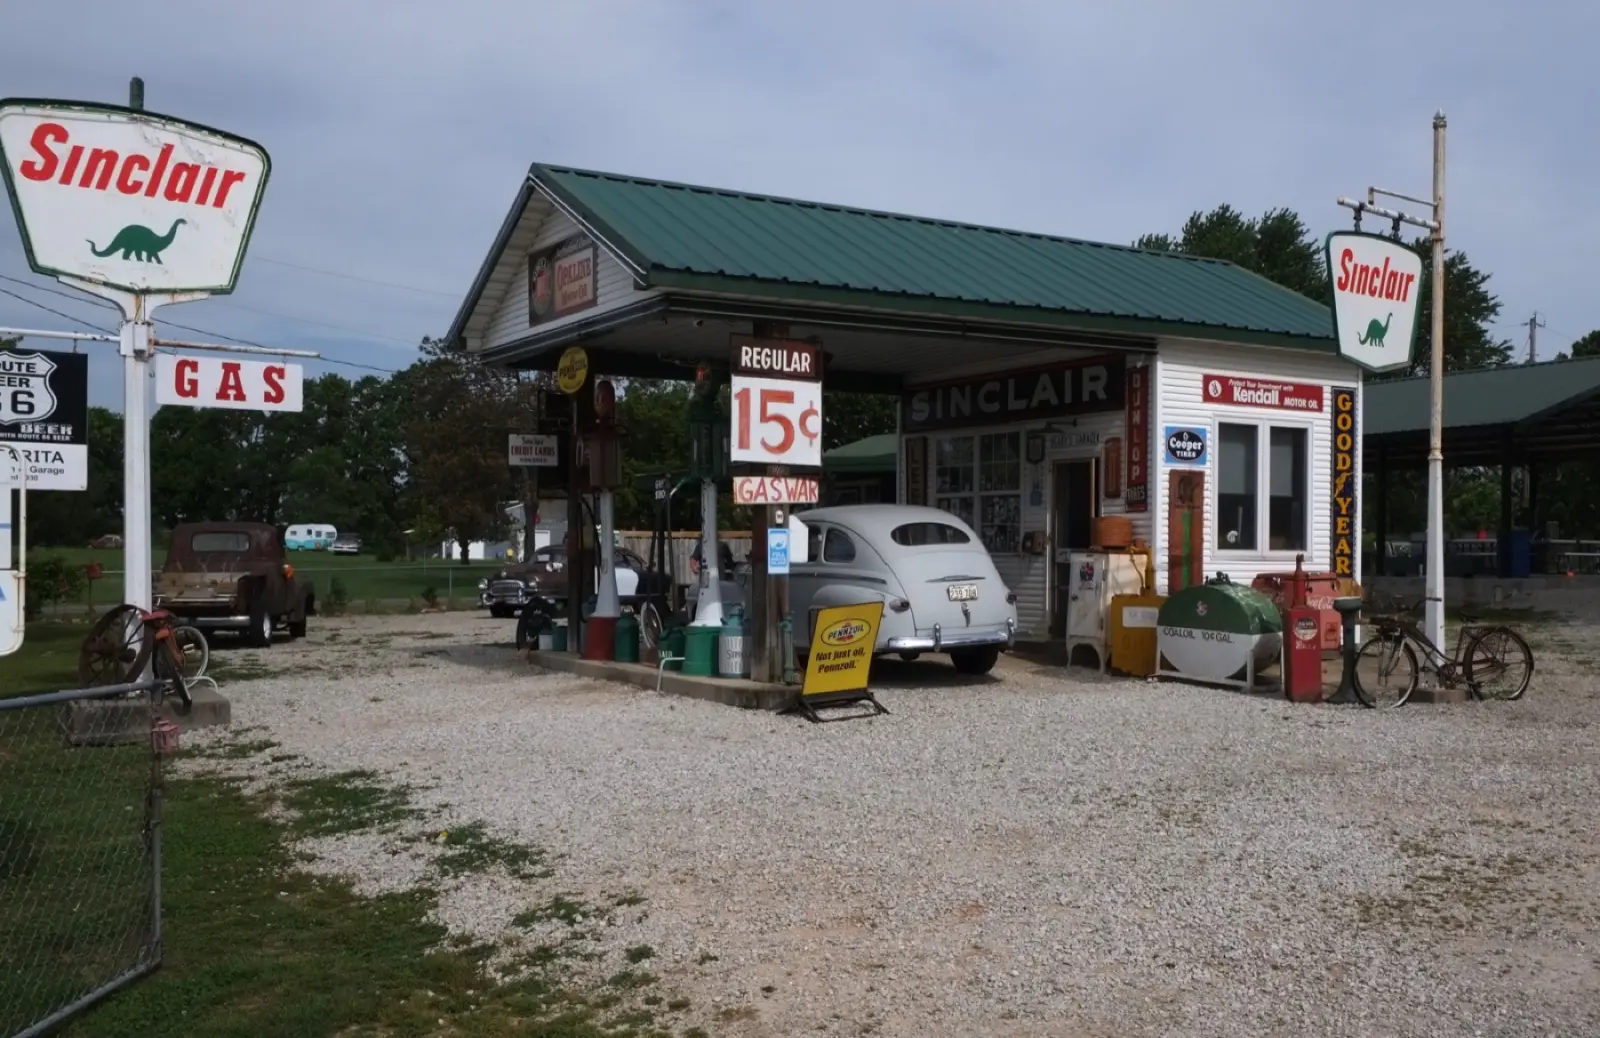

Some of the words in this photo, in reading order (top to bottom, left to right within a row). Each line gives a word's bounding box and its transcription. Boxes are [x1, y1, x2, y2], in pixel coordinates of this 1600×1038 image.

[20, 123, 245, 208] Sinclair
[1337, 248, 1414, 303] Sinclair
[0, 361, 36, 373] UTE
[741, 346, 811, 373] REGULAR
[0, 376, 30, 388] EER
[174, 359, 286, 404] GAS
[911, 365, 1108, 422] SINCLAIR
[1233, 386, 1279, 405] Kendall
[0, 390, 35, 415] 6
[1284, 397, 1306, 408] MOTOR
[1308, 400, 1318, 409] OIL
[21, 423, 73, 435] BEER
[1131, 373, 1141, 481] DUNLOP
[1170, 437, 1202, 451] Cooper
[8, 449, 64, 463] ARITA
[29, 466, 65, 475] Garage
[738, 475, 782, 502] GAS
[828, 624, 865, 640] PENNZOIL
[816, 651, 833, 662] Not
[833, 648, 851, 661] just
[853, 647, 866, 657] oil,
